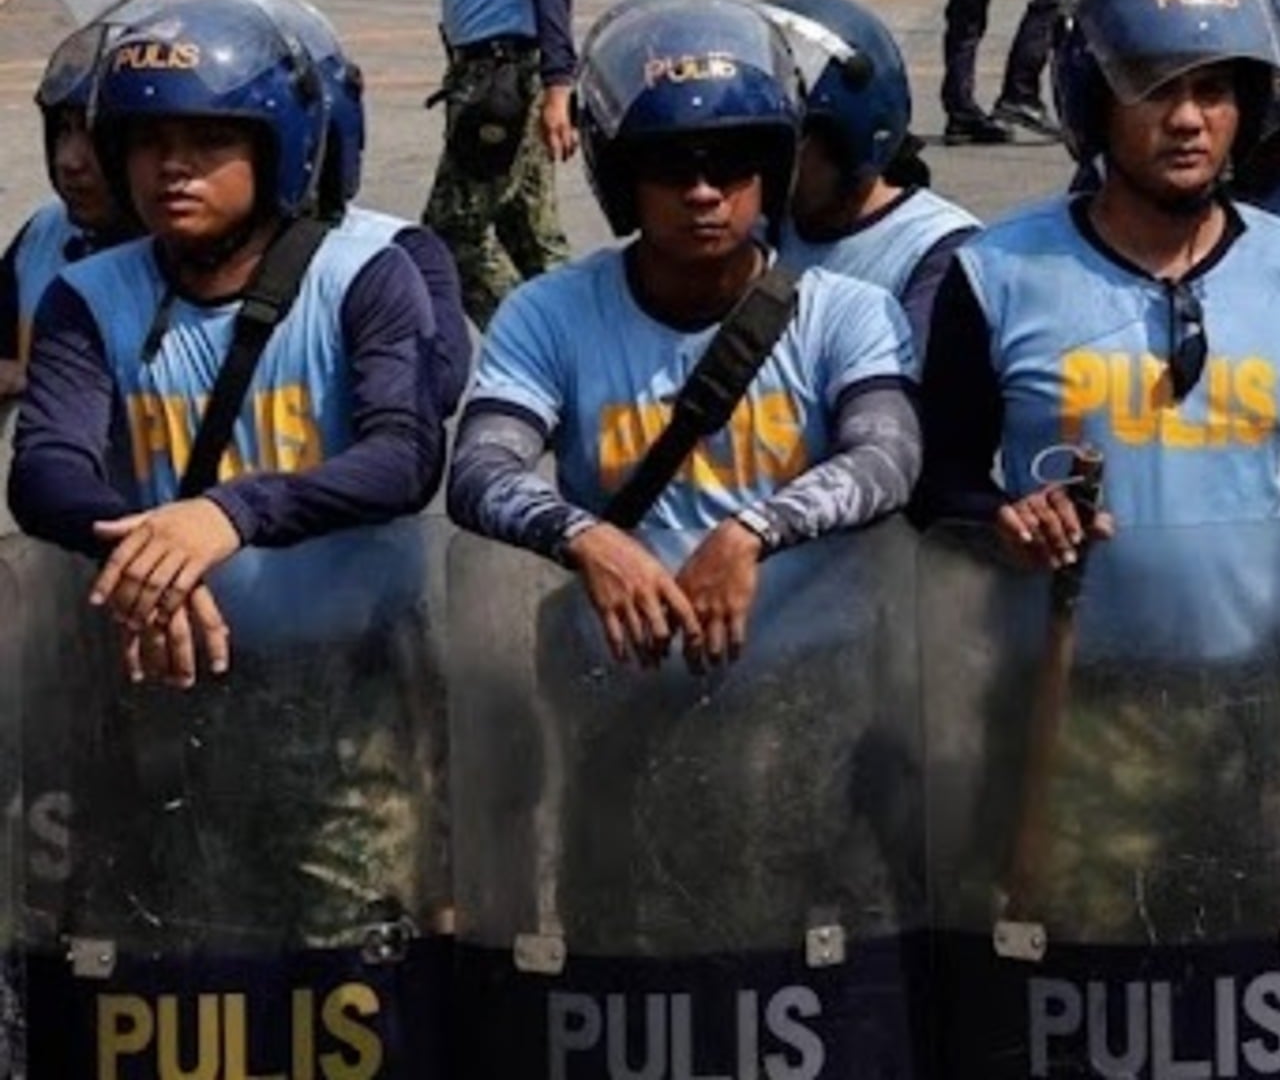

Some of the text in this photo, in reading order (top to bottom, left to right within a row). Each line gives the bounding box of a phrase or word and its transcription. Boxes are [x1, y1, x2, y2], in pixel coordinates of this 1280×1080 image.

[113, 42, 200, 71] PULIS
[97, 982, 384, 1080] PULIS
[547, 985, 826, 1080] PULIS
